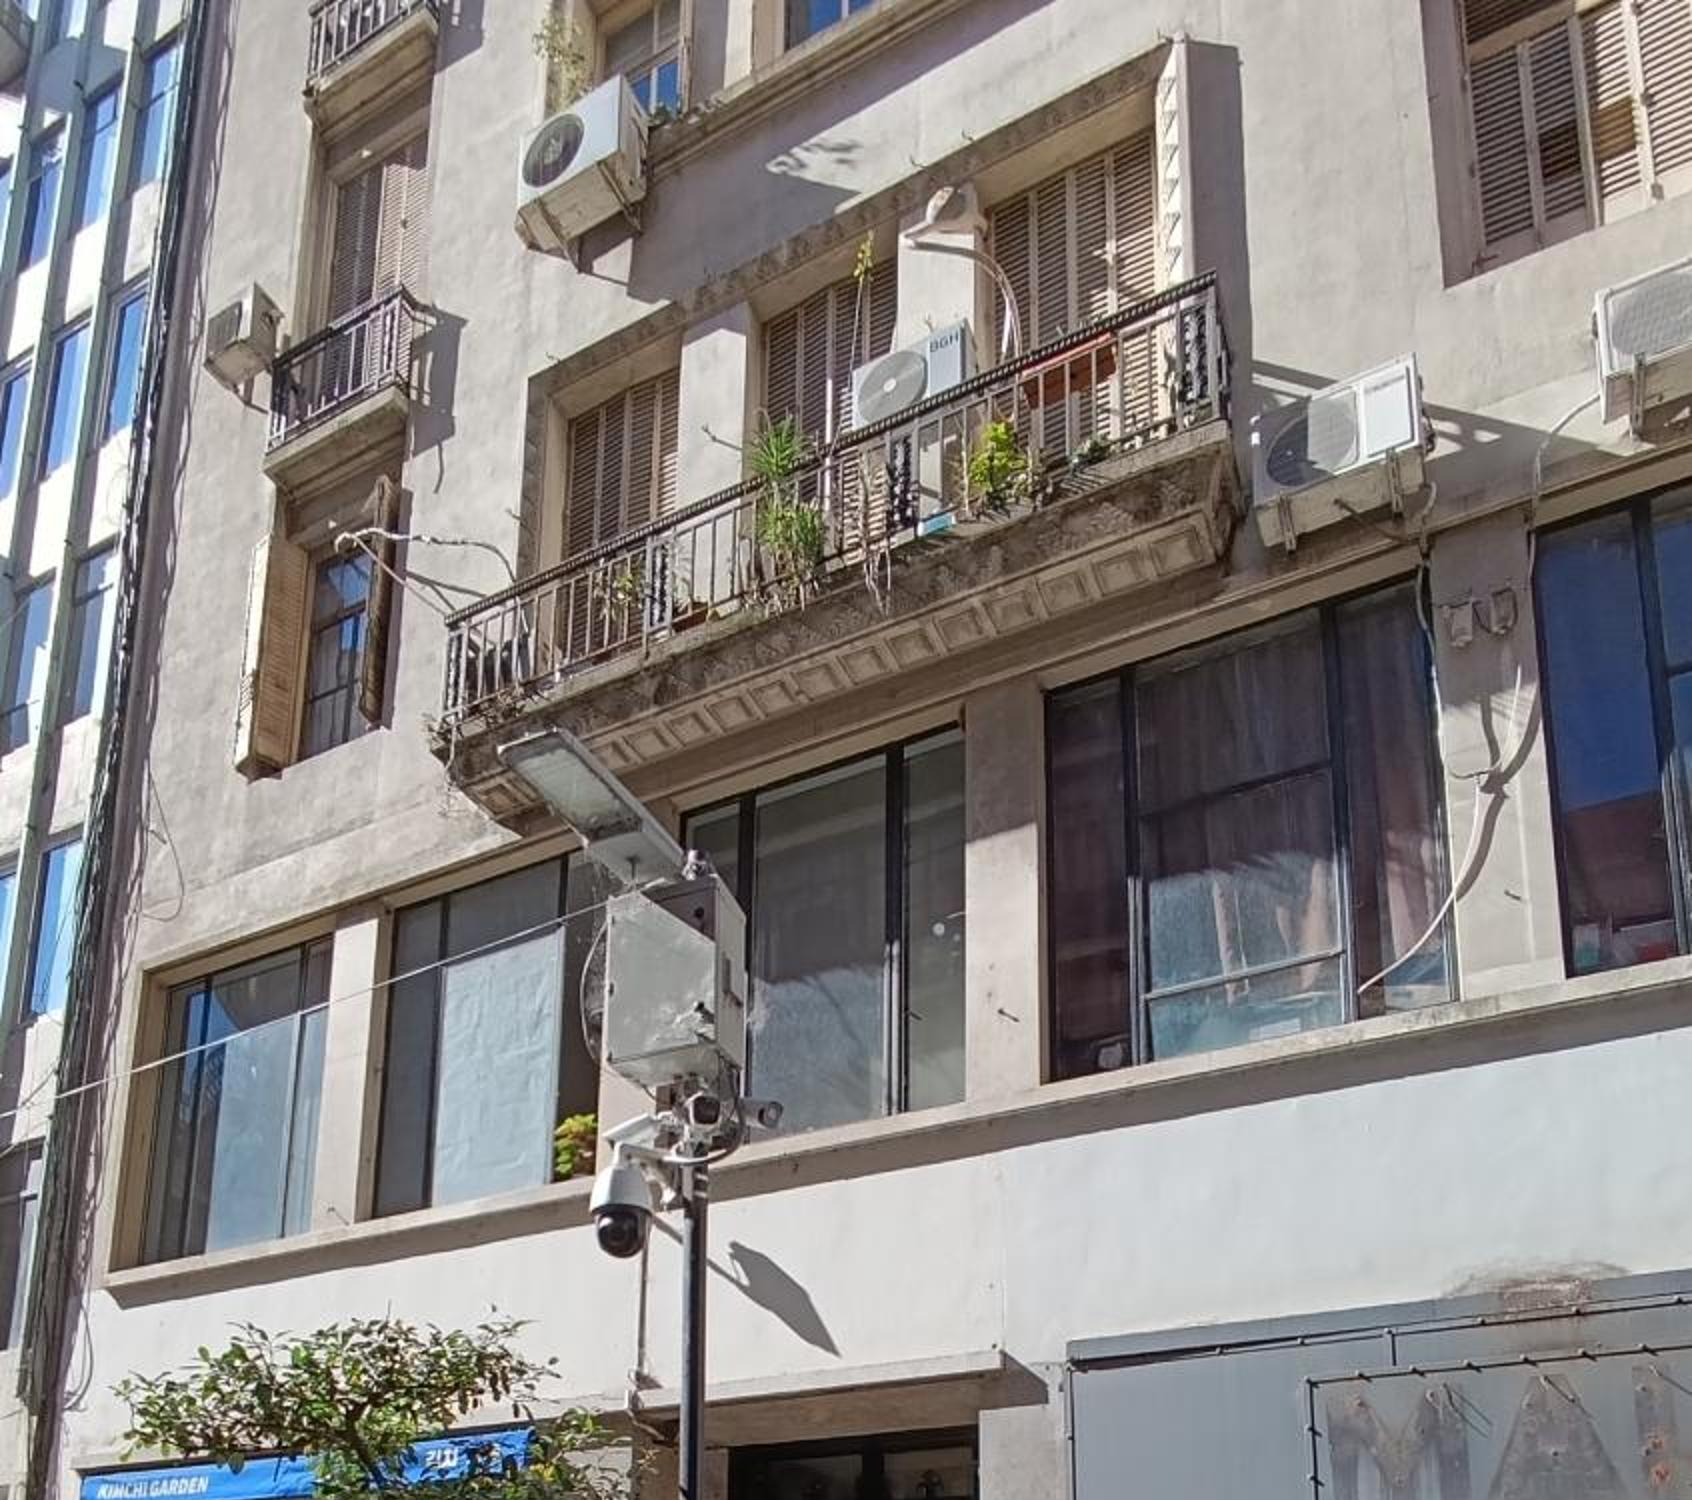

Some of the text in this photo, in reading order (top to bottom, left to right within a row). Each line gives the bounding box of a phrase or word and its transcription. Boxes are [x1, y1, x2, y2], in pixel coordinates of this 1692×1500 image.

[930, 330, 959, 352] BGH
[96, 1476, 209, 1500] KIMCHI GARDEN
